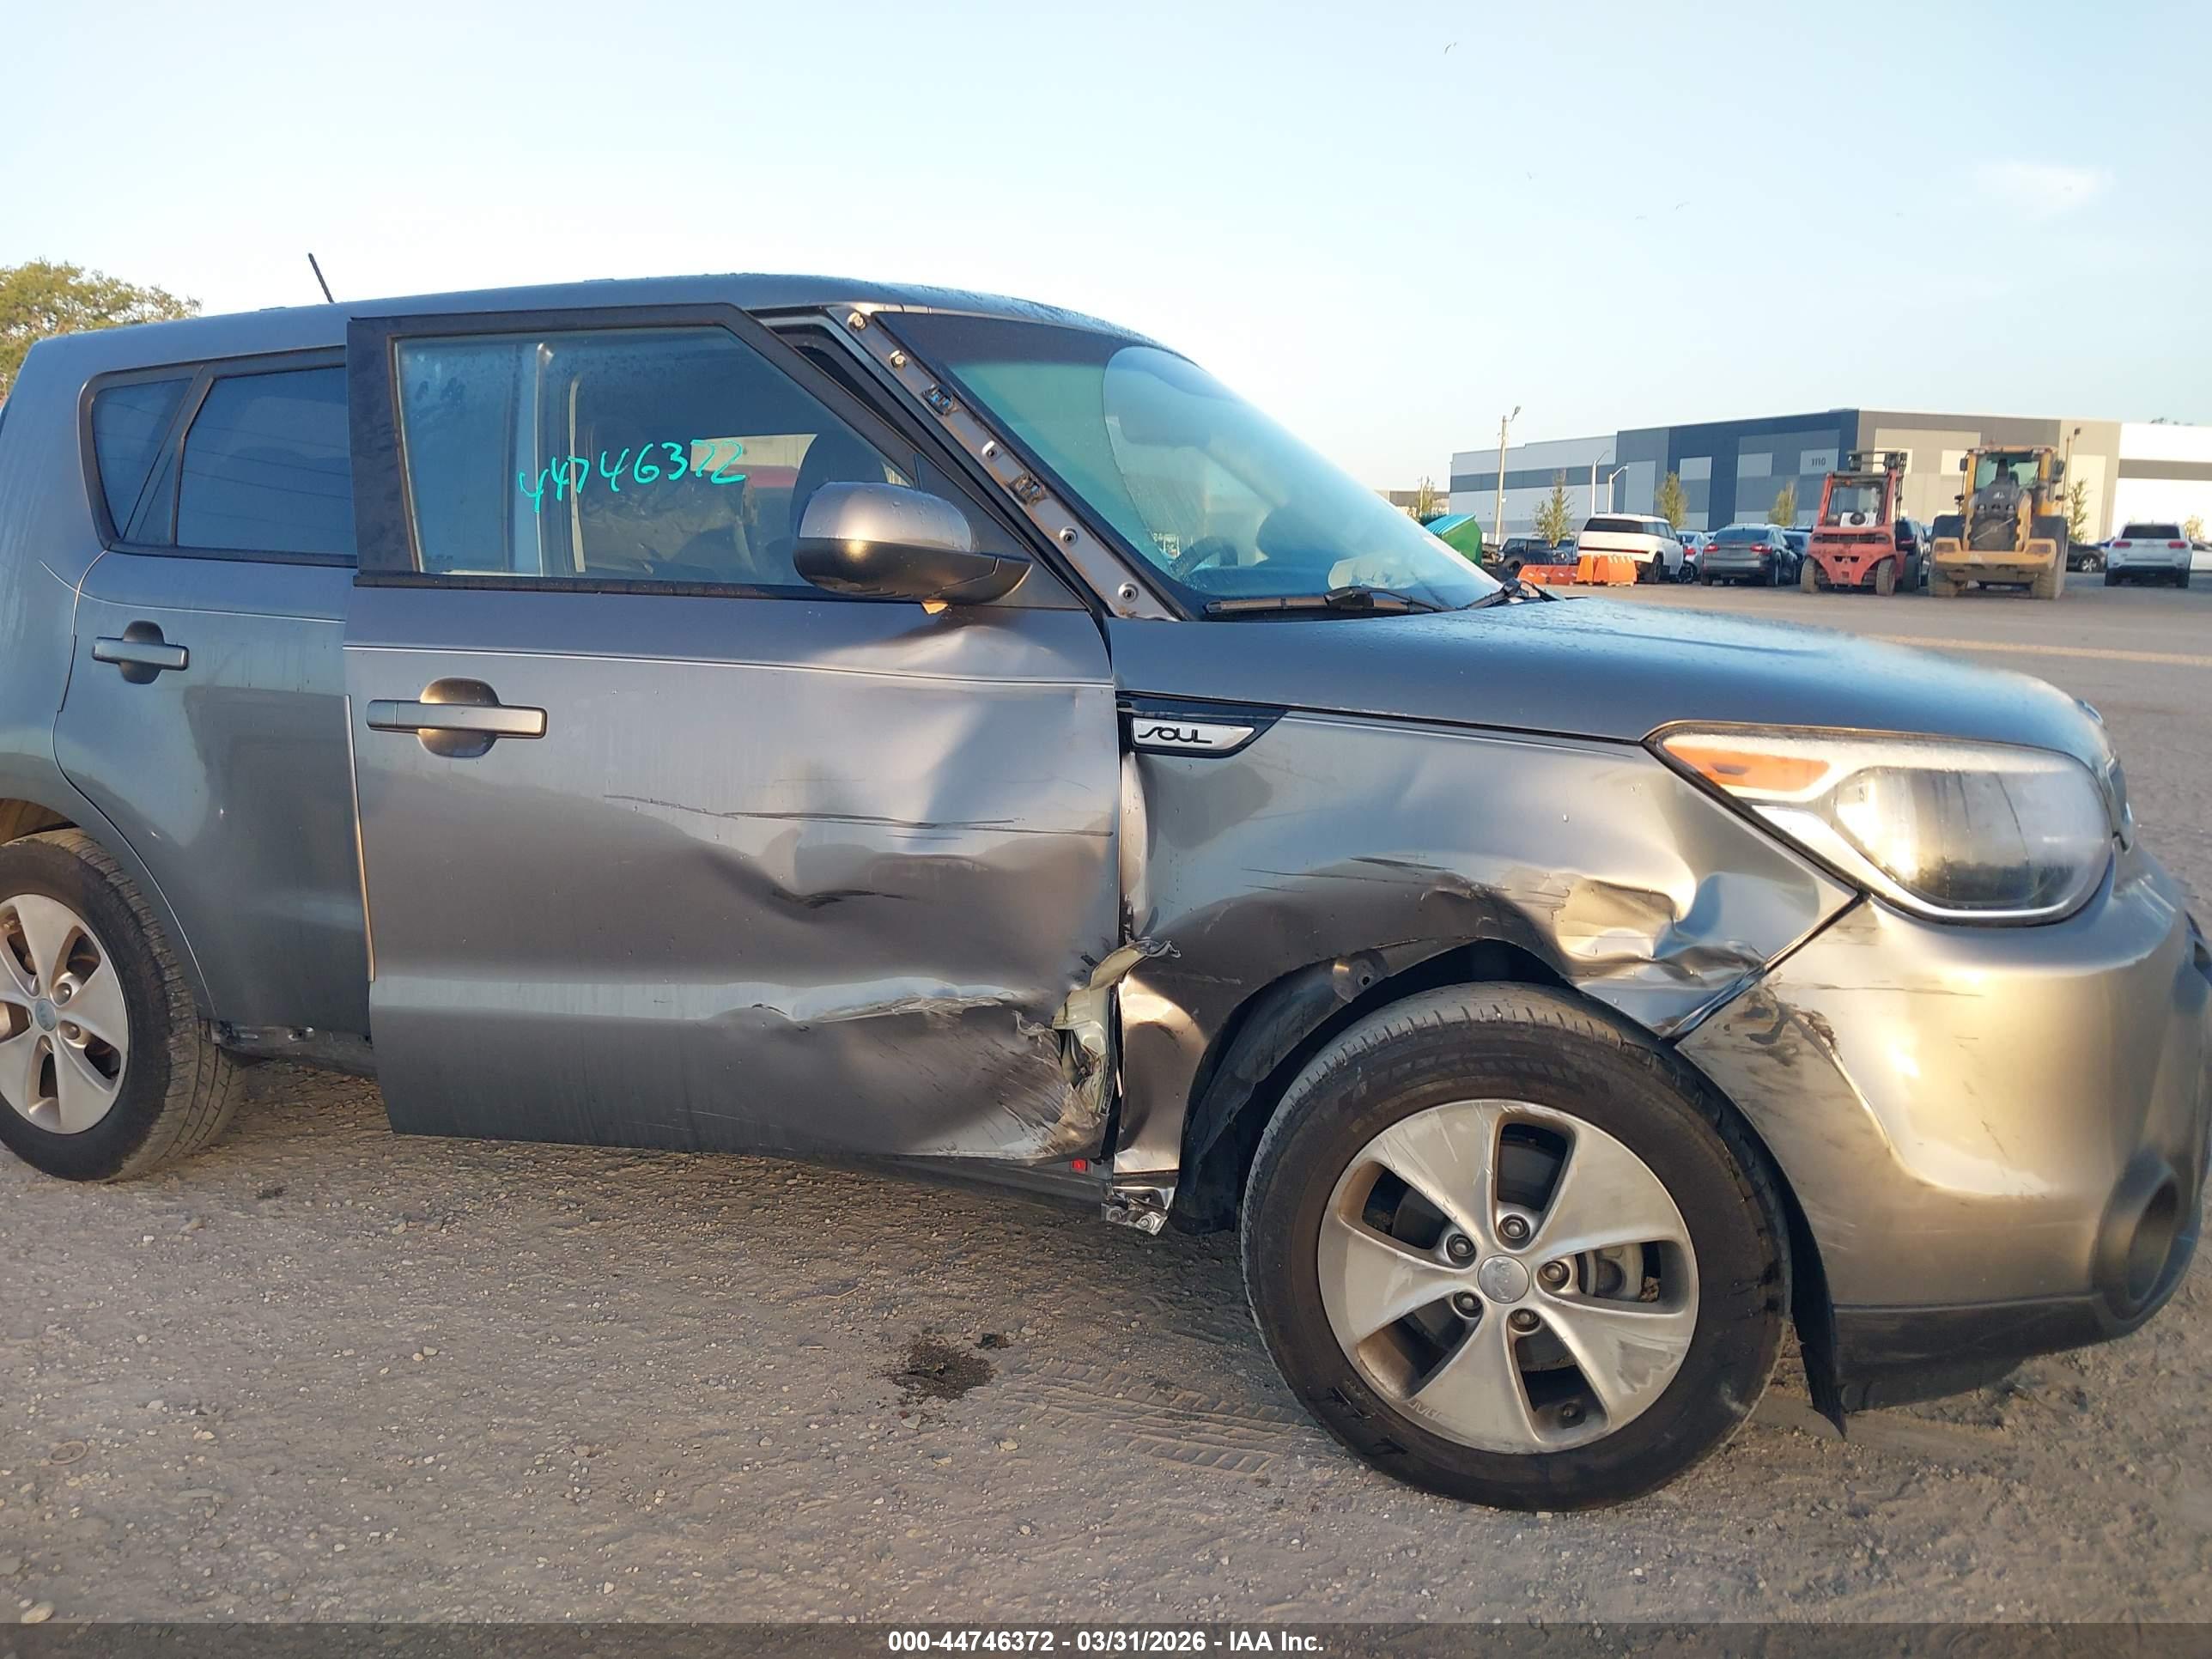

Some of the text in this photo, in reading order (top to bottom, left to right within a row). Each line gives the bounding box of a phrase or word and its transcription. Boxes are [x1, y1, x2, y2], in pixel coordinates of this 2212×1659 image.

[1811, 457, 1826, 467] 1110
[519, 439, 747, 514] 44746372
[1138, 726, 1212, 744] SOUL
